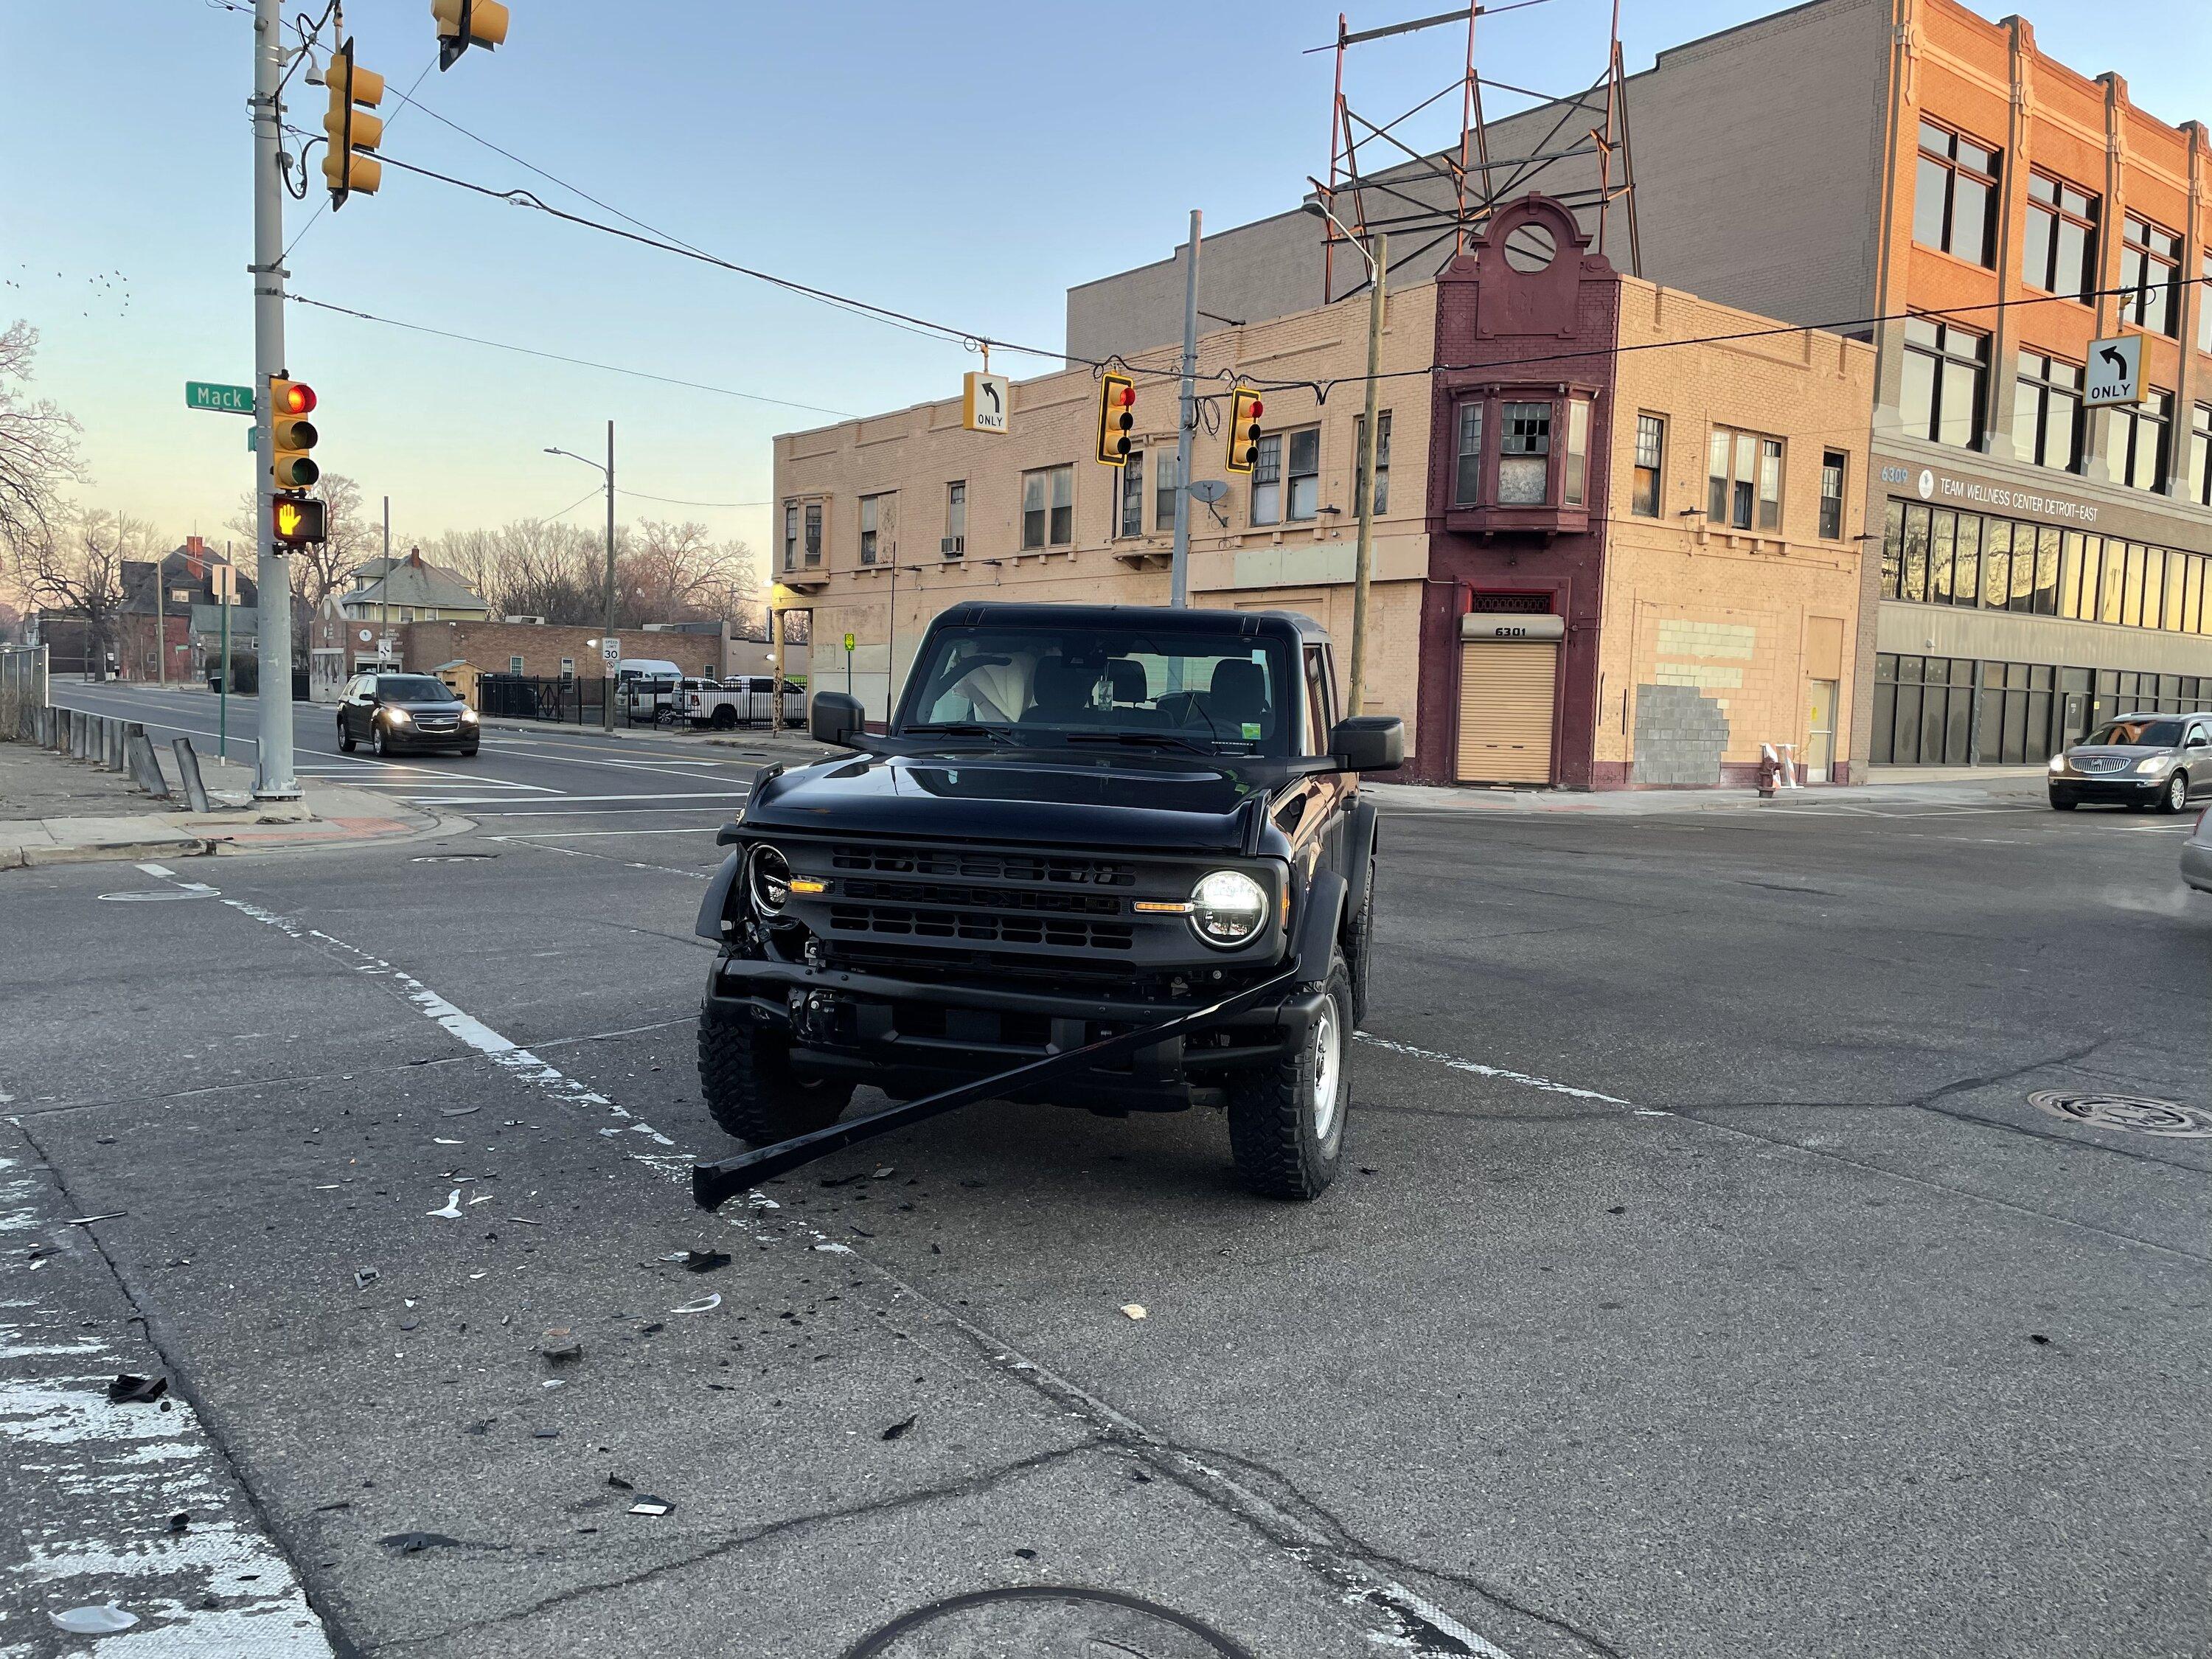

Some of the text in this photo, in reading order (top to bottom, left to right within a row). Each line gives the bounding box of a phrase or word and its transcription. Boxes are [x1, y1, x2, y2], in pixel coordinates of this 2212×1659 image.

[197, 386, 242, 408] Mack
[2091, 383, 2131, 399] ONLY
[978, 414, 1003, 427] ONLY
[1881, 465, 1908, 484] 6309
[1940, 478, 2098, 522] TEAM WELLNESS CENTER DETROIT-EAST
[1495, 627, 1526, 636] 6301
[605, 650, 618, 658] 30
